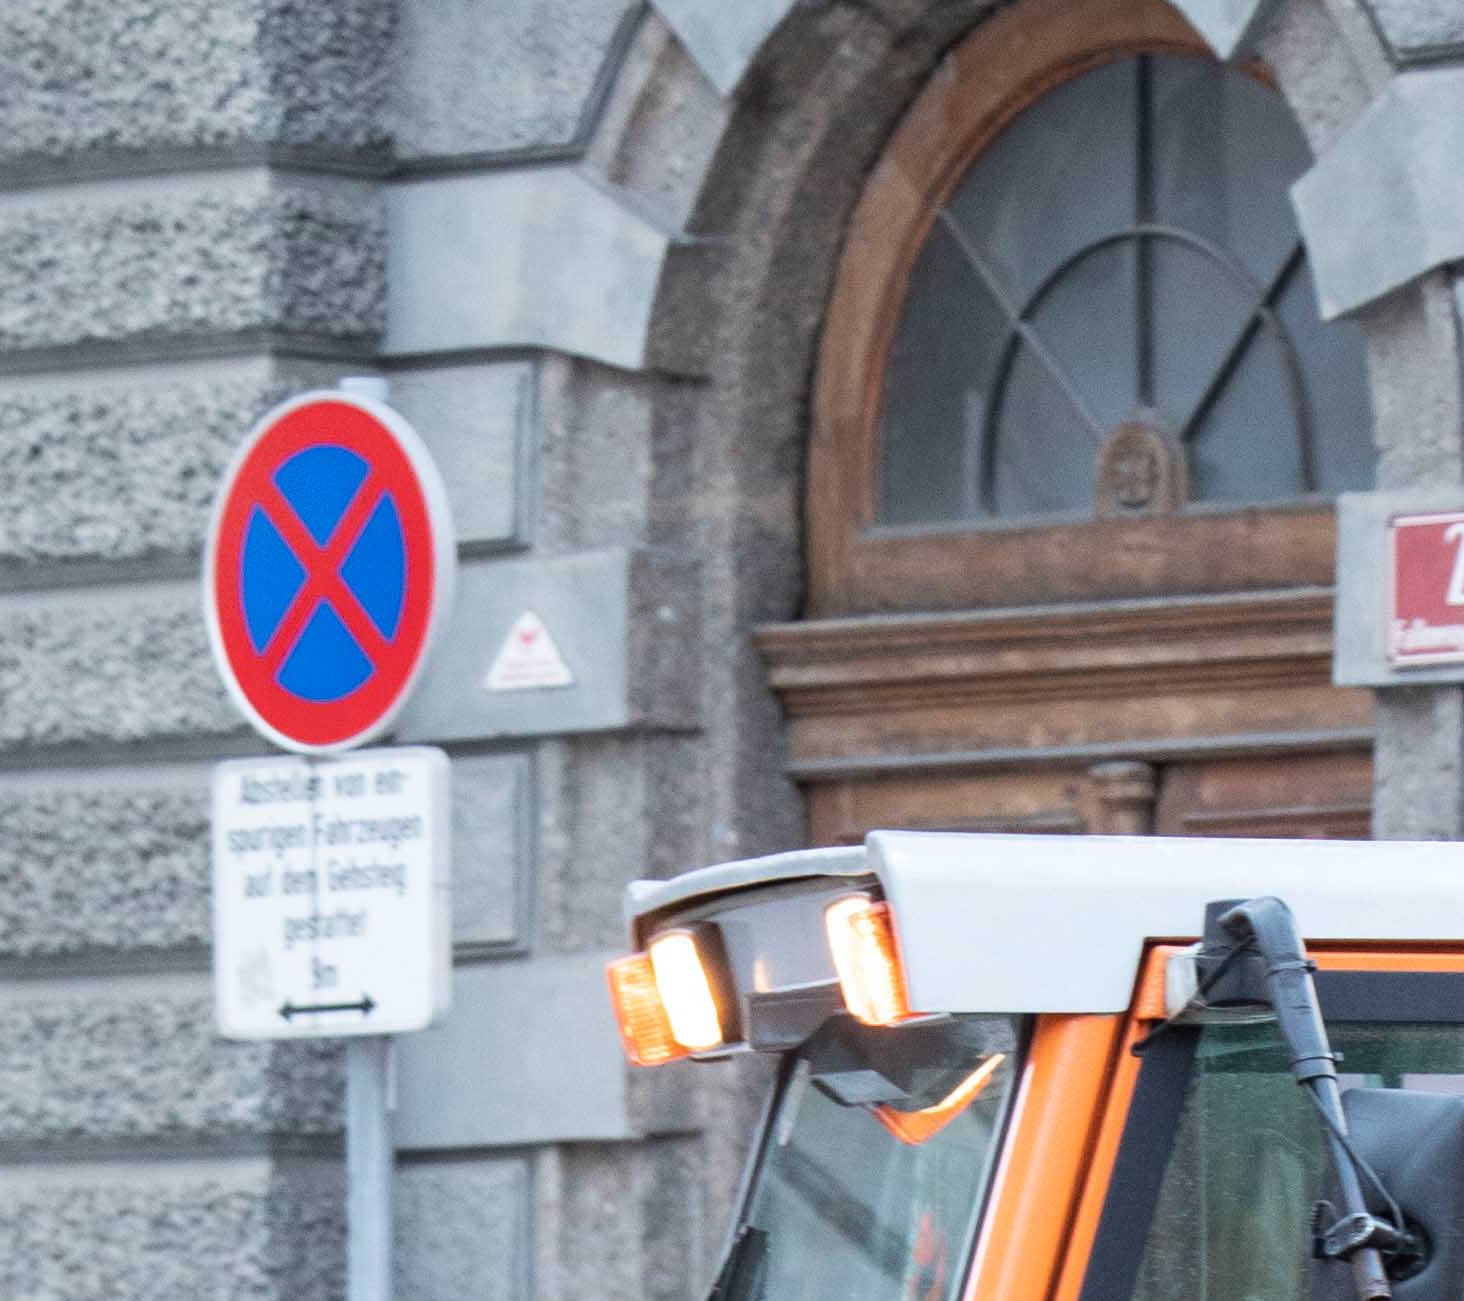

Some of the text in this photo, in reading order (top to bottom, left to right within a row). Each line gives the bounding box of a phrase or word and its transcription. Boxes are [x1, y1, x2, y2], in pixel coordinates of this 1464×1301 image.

[335, 773, 366, 797] von
[244, 866, 274, 898] auf
[282, 868, 318, 895] dem
